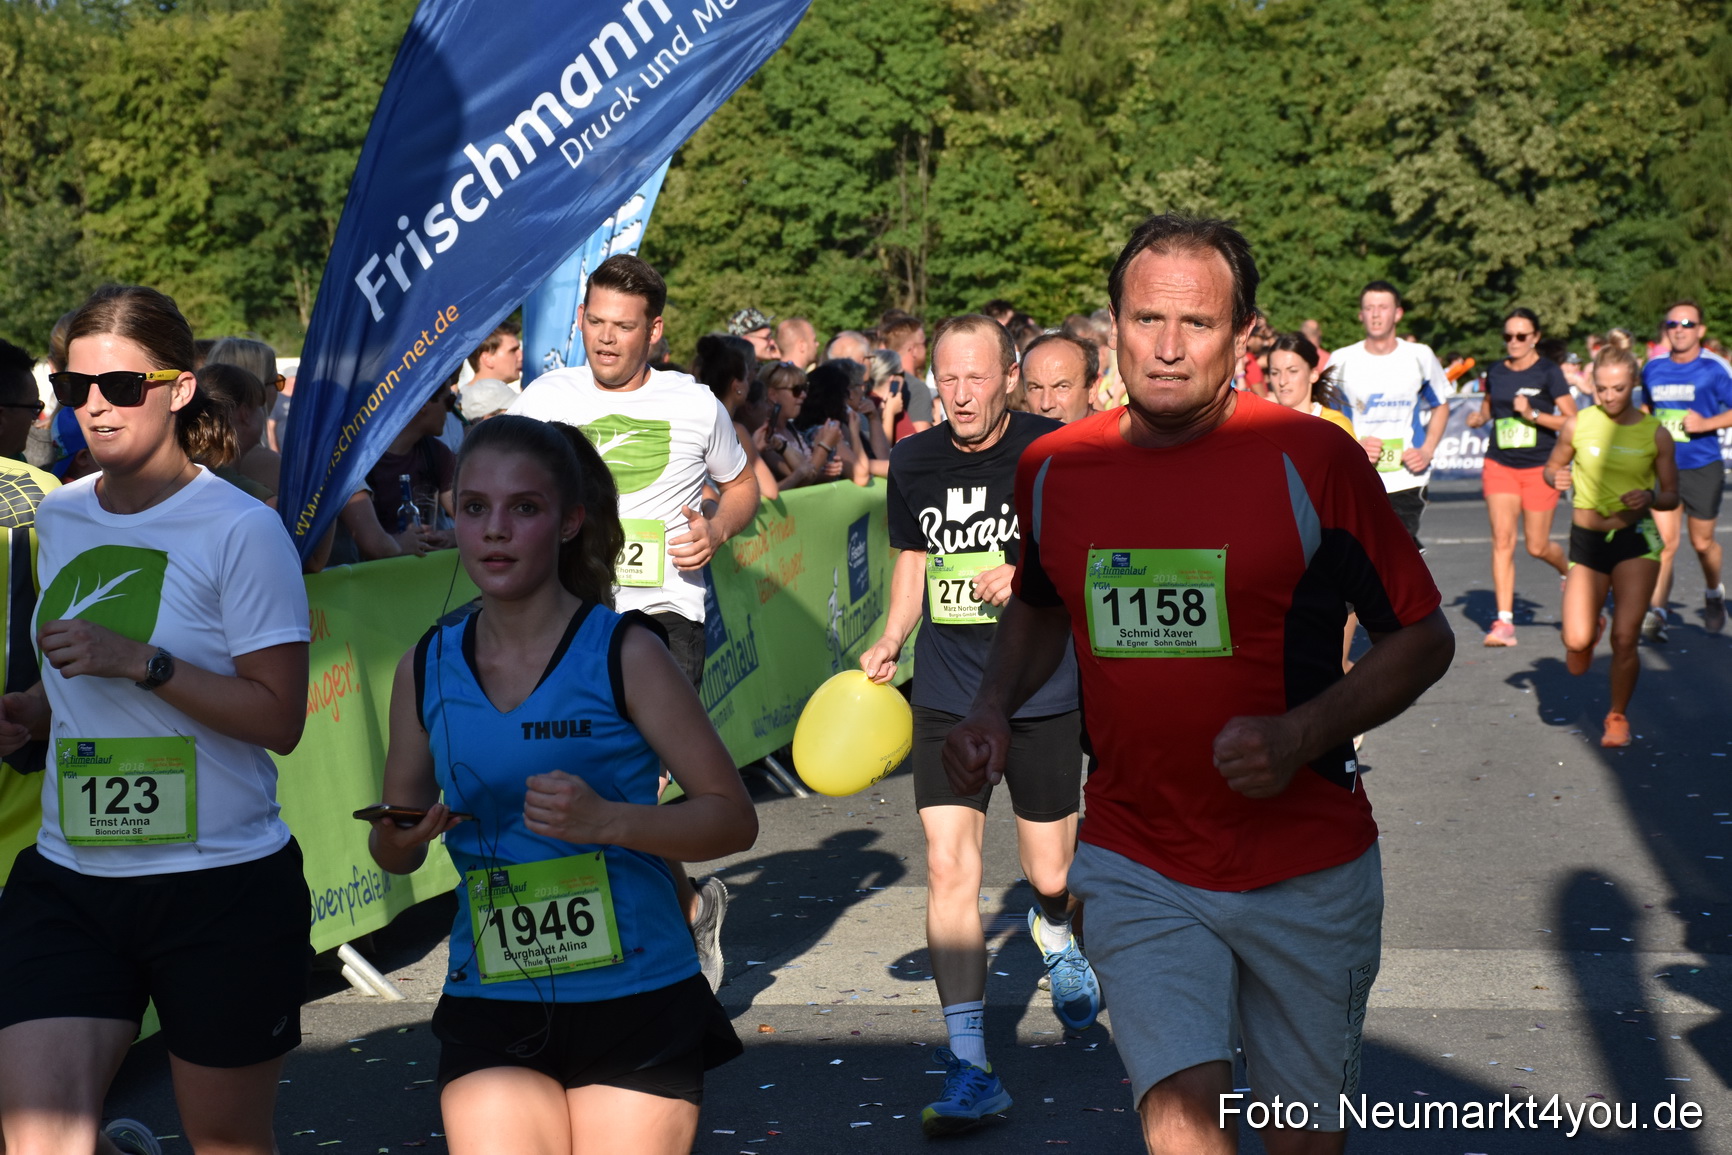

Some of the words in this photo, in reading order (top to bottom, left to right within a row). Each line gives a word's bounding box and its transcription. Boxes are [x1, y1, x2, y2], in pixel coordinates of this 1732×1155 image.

[559, 83, 641, 169] Druck
[639, 24, 694, 89] und
[354, 0, 673, 324] Frischmann
[1102, 565, 1148, 576] firmenlauf
[1102, 588, 1207, 627] 1158
[1119, 628, 1160, 638] Schmid
[1163, 628, 1193, 638] Xaver
[1126, 640, 1148, 648] Egner
[700, 613, 760, 712] irmenlauf
[521, 719, 592, 740] THULE
[70, 754, 113, 764] firmenlauf
[81, 776, 160, 815] 123
[89, 817, 118, 827] Ernst
[120, 817, 150, 827] Anna
[95, 828, 131, 836] Bionorica
[132, 827, 143, 835] SE
[489, 896, 595, 949] 1946
[503, 944, 556, 961] Burghardt
[559, 940, 588, 954] Alina
[523, 959, 543, 968] Thule
[544, 955, 568, 965] GmbH
[1353, 963, 1371, 1027] PORTO
